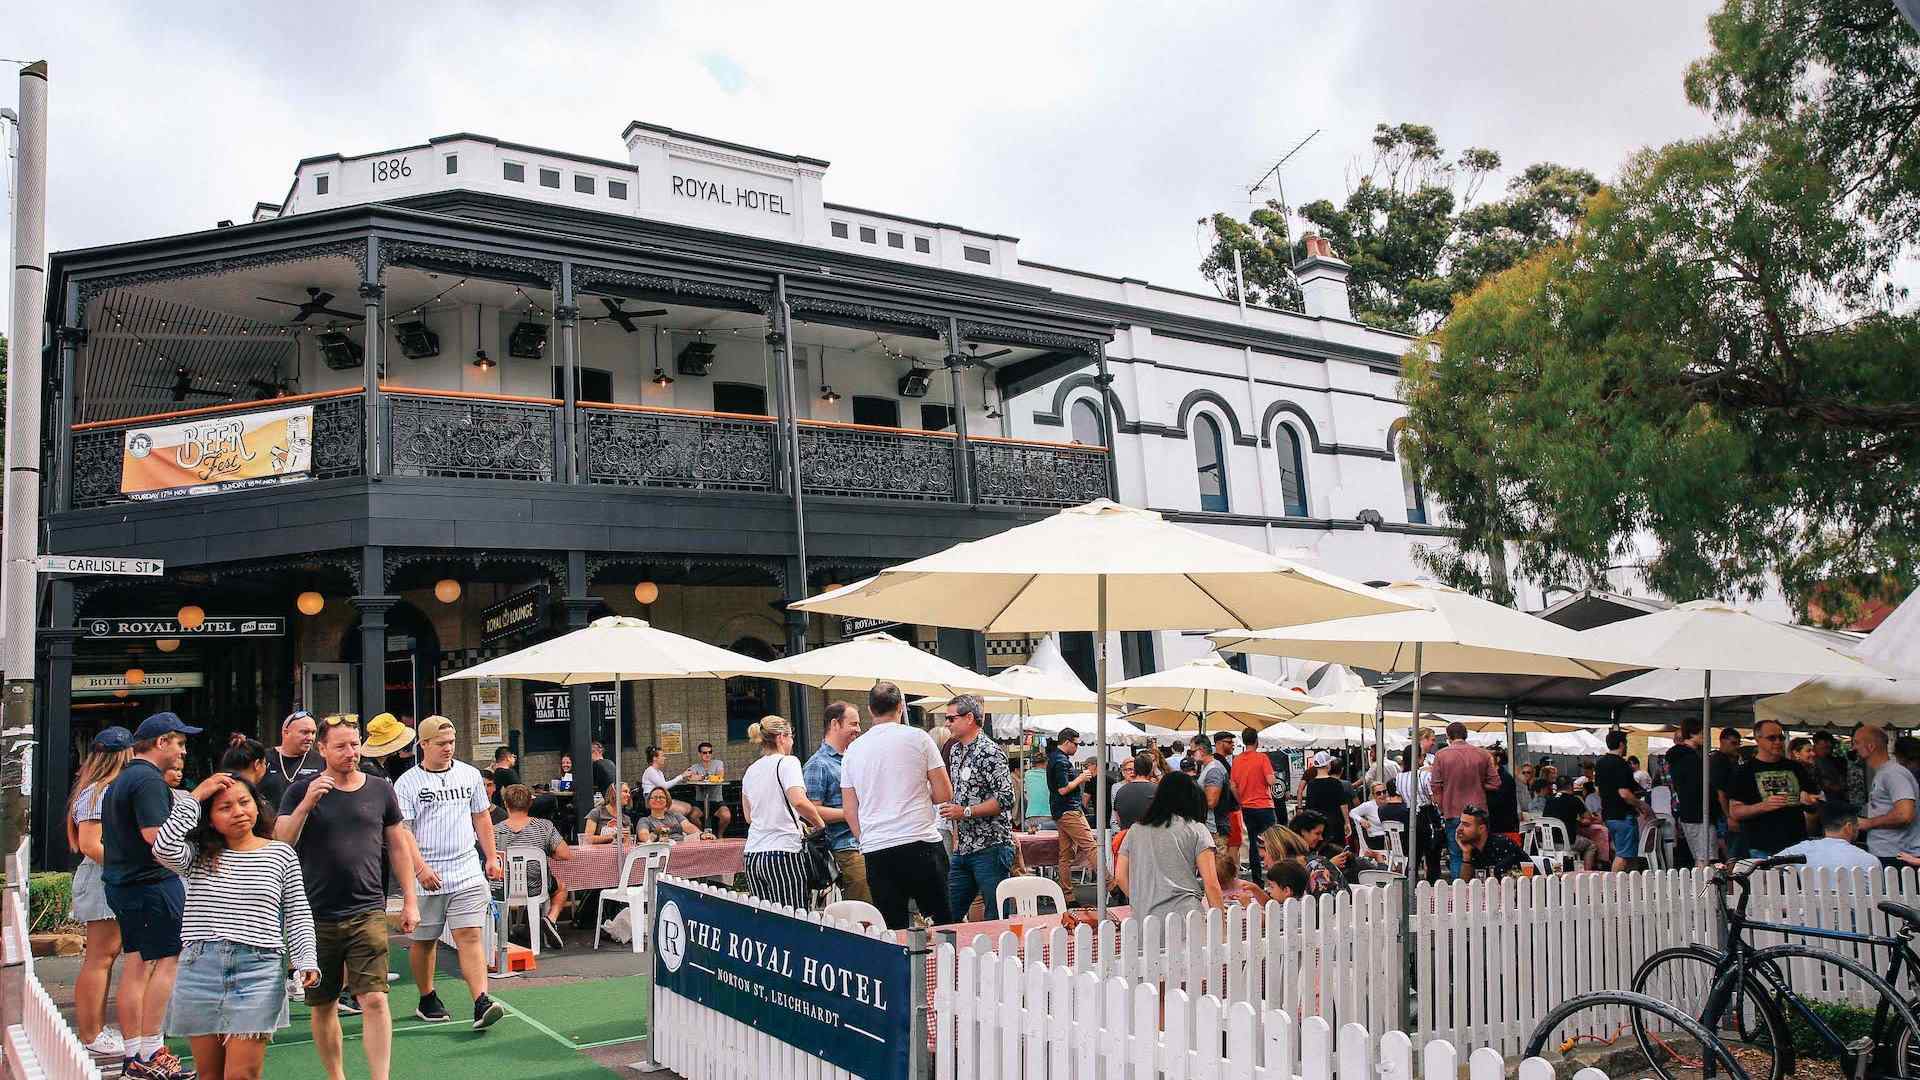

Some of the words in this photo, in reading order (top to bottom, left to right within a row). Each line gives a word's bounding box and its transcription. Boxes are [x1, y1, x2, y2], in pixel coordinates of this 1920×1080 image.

[372, 156, 411, 183] 1886
[672, 175, 732, 205] ROYAL
[736, 187, 791, 215] HOTEL
[176, 419, 256, 469] BEER
[199, 449, 242, 480] Fest
[174, 488, 187, 496] NOV
[222, 481, 246, 490] SUNDAY
[68, 559, 127, 572] CARLISLE
[135, 561, 149, 572] ST
[487, 615, 502, 633] ROYAL
[510, 602, 534, 624] LOUNGE
[854, 619, 877, 630] ROYAL
[95, 623, 106, 632] R
[118, 622, 176, 633] ROYAL
[90, 677, 128, 686] BOTTL
[534, 695, 554, 709] WE
[535, 708, 555, 718] 10AM
[604, 707, 617, 716] AYS
[418, 786, 472, 803] Saints
[663, 920, 680, 956] R
[687, 919, 721, 952] THE
[727, 931, 793, 978] ROYAL
[802, 956, 888, 1011] HOTEL
[716, 967, 751, 993] NORTON
[753, 983, 769, 1002] ST,
[771, 989, 840, 1028] LEICHHARDT
